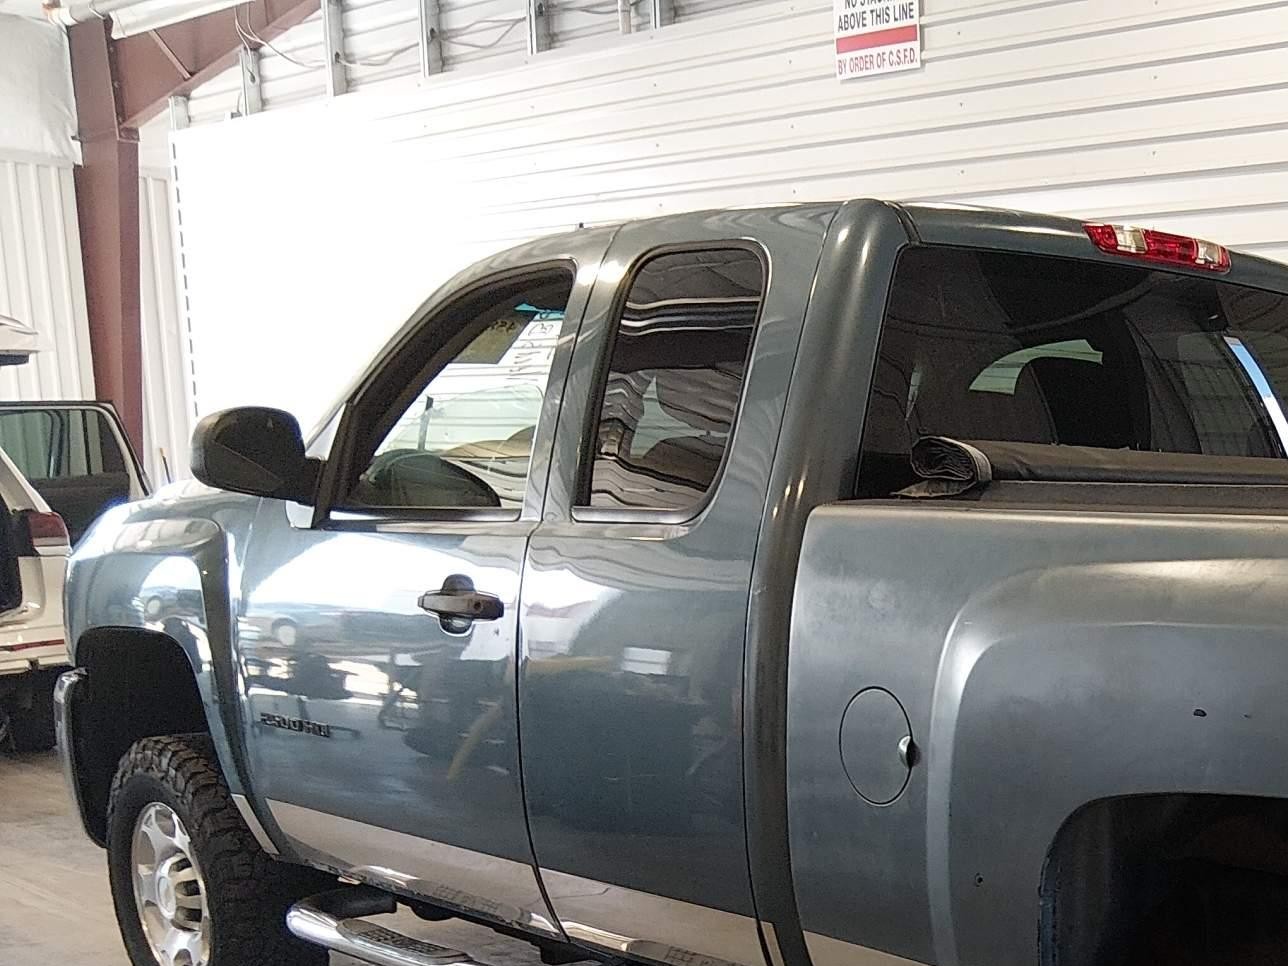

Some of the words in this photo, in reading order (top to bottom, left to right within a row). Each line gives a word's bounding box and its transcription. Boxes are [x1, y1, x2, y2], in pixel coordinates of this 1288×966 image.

[838, 11, 867, 32] ABOVE
[870, 6, 890, 26] THIS
[893, 2, 914, 21] LINE
[838, 59, 847, 75] BY
[849, 54, 875, 73] ORDER
[876, 51, 886, 68] OF
[888, 47, 918, 67] C.S.F.D.
